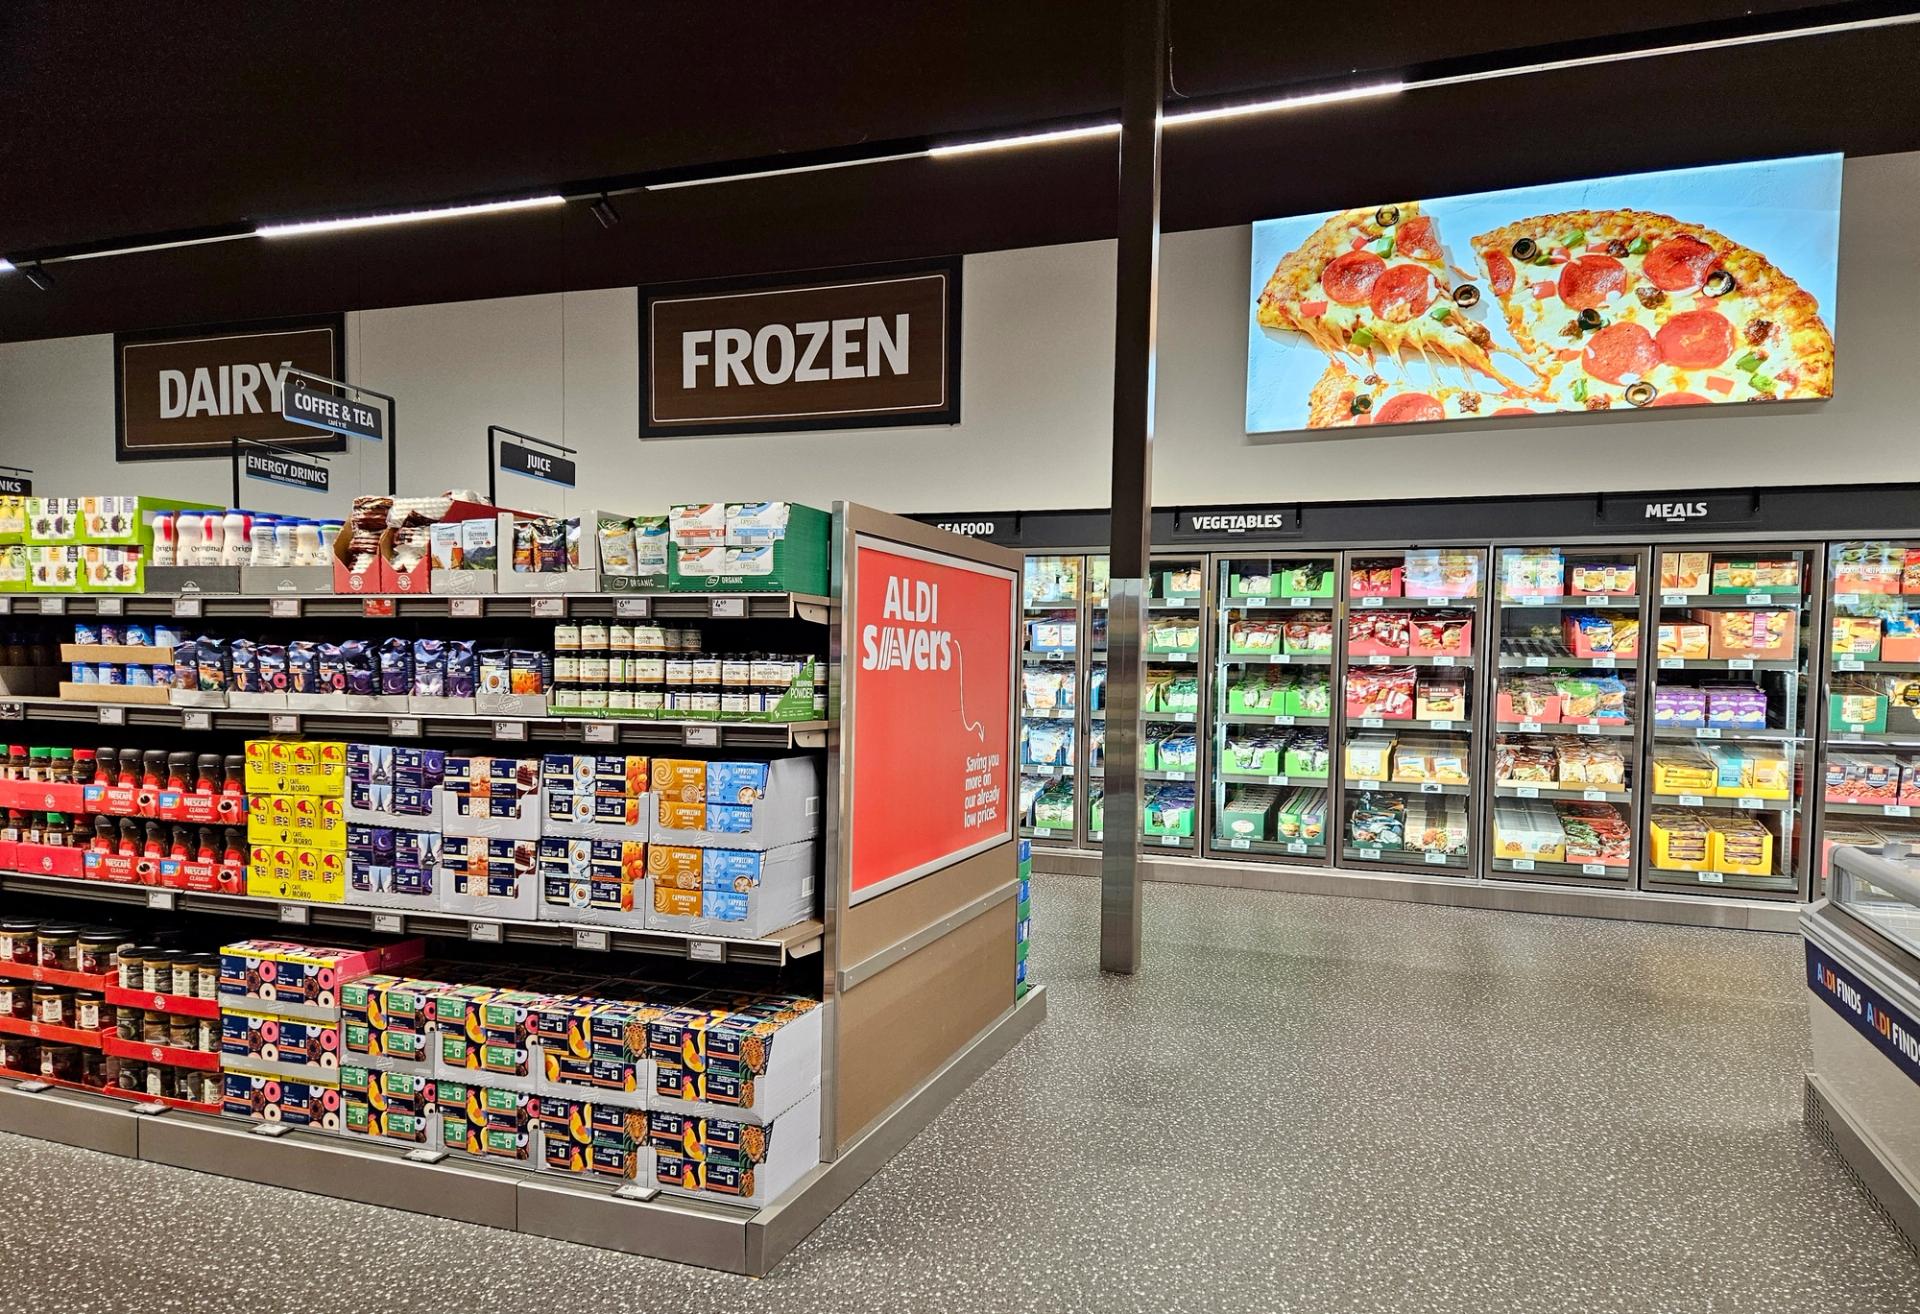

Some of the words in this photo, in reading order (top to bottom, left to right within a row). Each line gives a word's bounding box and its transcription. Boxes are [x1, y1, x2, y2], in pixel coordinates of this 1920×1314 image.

[682, 313, 909, 389] FROZEN
[159, 361, 292, 419] DAIRY
[295, 393, 339, 419] COFFEE
[341, 405, 351, 422] &
[353, 408, 374, 428] TEA
[248, 456, 288, 475] ENERGY
[290, 465, 327, 484] DRINKS
[527, 453, 551, 472] JUICE
[1645, 502, 1708, 518] MEALS
[1192, 514, 1282, 530] VEGETABLES
[721, 576, 743, 584] ORGANIC
[883, 575, 938, 624] ALDI
[790, 687, 813, 699] POWDER
[966, 753, 987, 773] Saving
[987, 754, 1000, 772] you
[290, 785, 310, 793] MORRO
[965, 774, 982, 791] more
[983, 773, 992, 786] on
[183, 796, 213, 807] NESCAFÉ
[965, 794, 976, 810] our
[977, 785, 1000, 805] already
[964, 811, 976, 829] low
[293, 837, 312, 845] MORRO
[105, 858, 132, 869] NESCAFÉ
[184, 866, 213, 877] NESCAFÉ
[292, 891, 311, 899] MORRO
[1817, 962, 1836, 994] ALDI
[1837, 978, 1862, 1015] FINDS
[1867, 1002, 1891, 1040] ALDI
[1892, 1022, 1920, 1067] FIND
